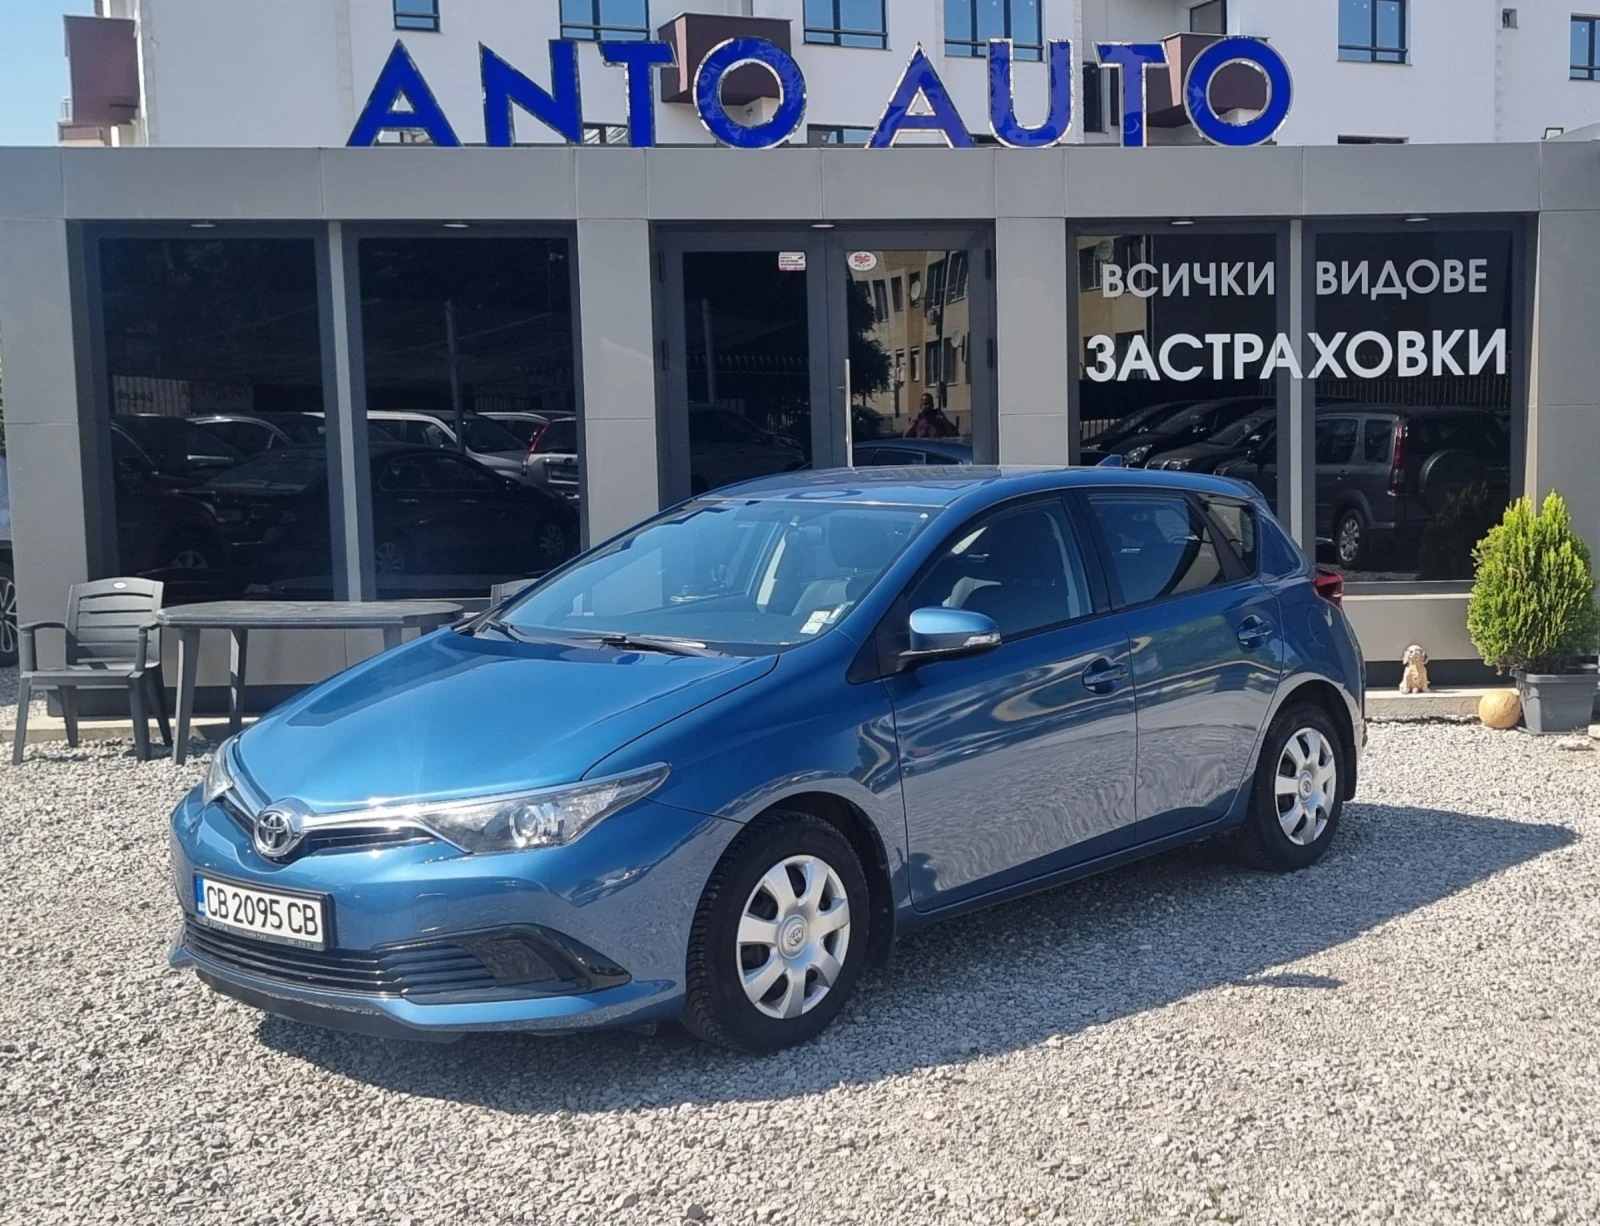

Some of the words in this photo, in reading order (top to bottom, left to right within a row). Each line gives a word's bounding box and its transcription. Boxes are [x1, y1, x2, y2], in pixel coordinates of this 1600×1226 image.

[345, 35, 808, 148] ANTO
[864, 36, 1294, 148] AUTO
[1101, 261, 1276, 298] ВСИЧКИ
[1315, 258, 1488, 300] ВИДОВЕ
[1085, 328, 1507, 382] ЗАСТРАХОВКИ
[206, 885, 229, 919] CB
[232, 892, 283, 930] 2095
[287, 902, 318, 936] CB
